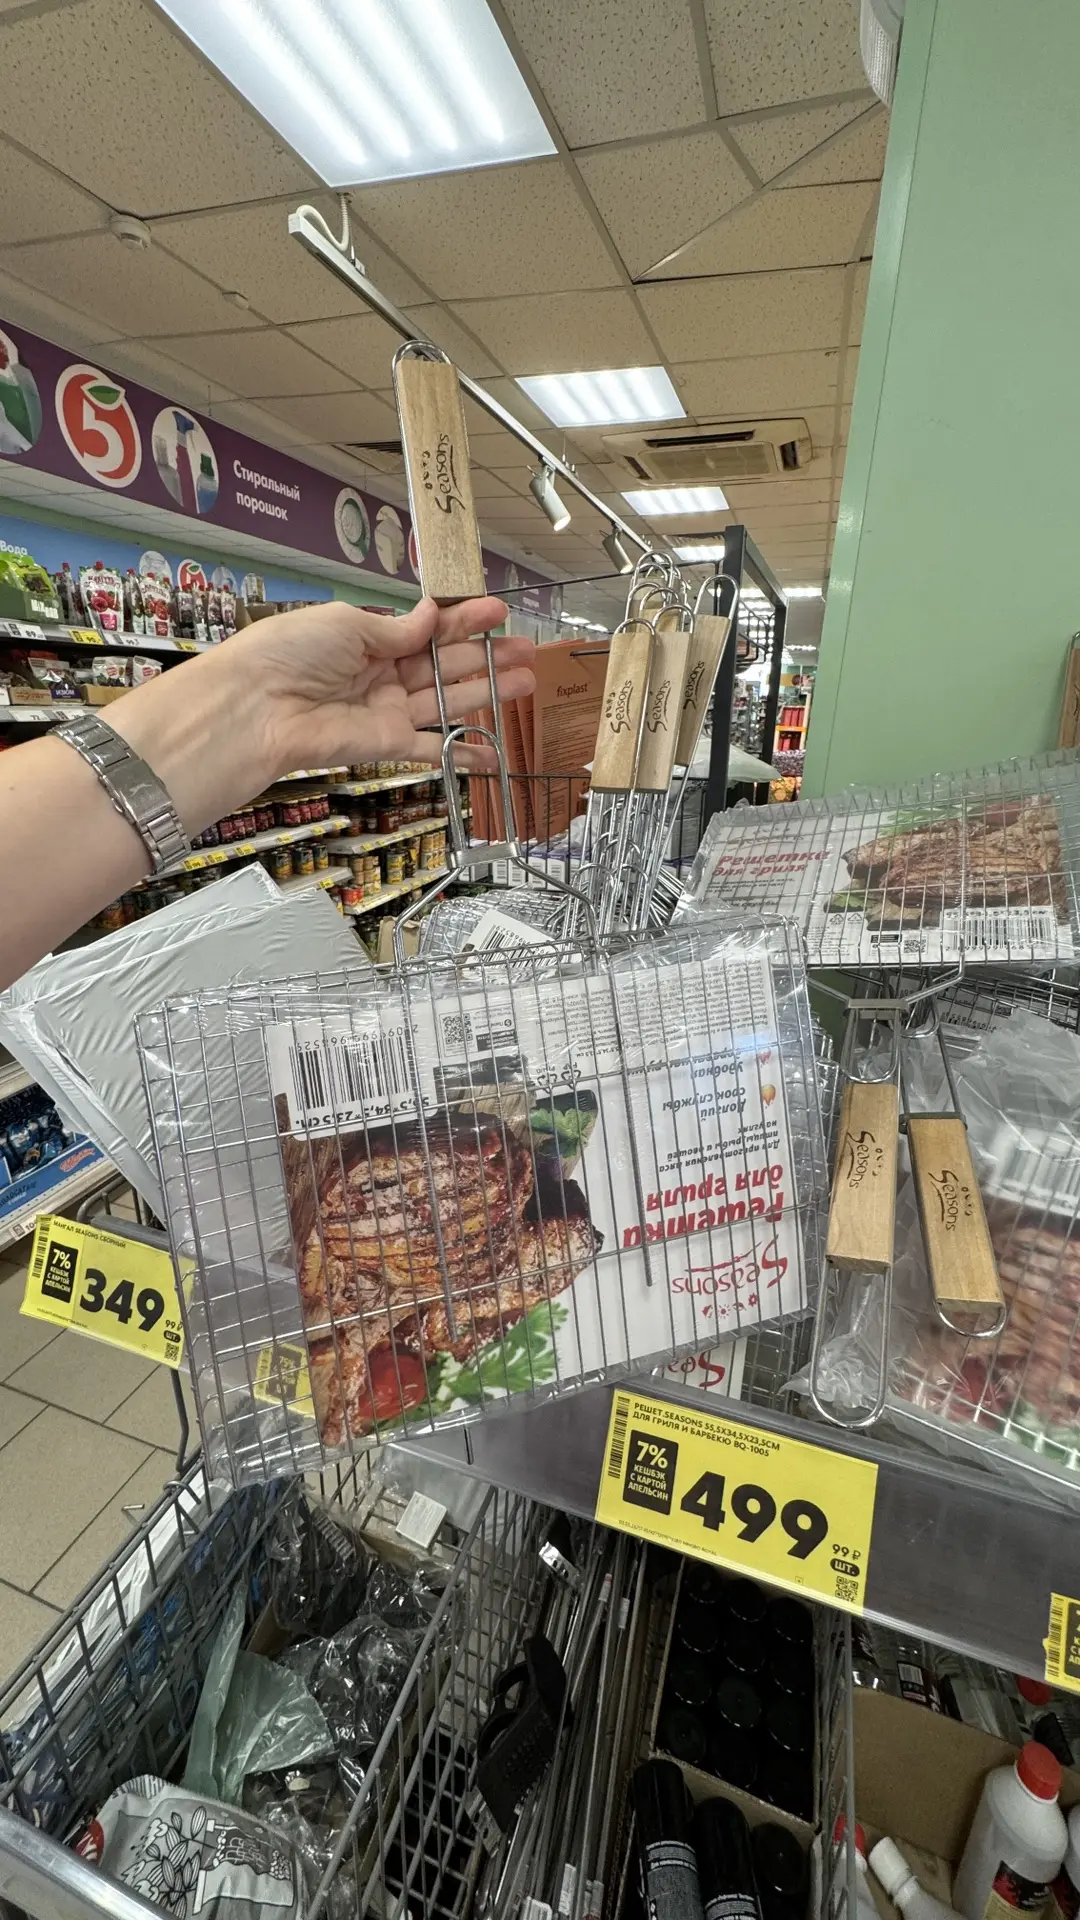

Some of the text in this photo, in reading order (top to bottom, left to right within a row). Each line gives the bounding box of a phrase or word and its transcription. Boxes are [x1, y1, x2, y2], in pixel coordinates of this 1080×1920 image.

[233, 460, 300, 501] Стиральный
[436, 433, 466, 515] Seasons
[236, 491, 288, 521] порошок
[556, 682, 588, 698] fixplast
[683, 660, 706, 712] Seasons
[610, 679, 633, 734] Seasons
[647, 679, 673, 733] Seasons
[691, 1061, 744, 1079] Удобная
[662, 1087, 745, 1112] срок службы
[700, 1099, 746, 1122] Долгий
[766, 1120, 777, 1128] на
[715, 1137, 742, 1151] рыбы
[846, 1130, 877, 1188] Seasons
[646, 1165, 783, 1212] для гриля
[928, 1168, 961, 1232] Seasons
[52, 1248, 72, 1269] 7%
[671, 1233, 788, 1297] Seasons
[50, 1266, 69, 1278] КЕШБЭК
[52, 1273, 70, 1286] КАРТОЙ
[44, 1279, 71, 1293] АПЕЛЬСИН
[79, 1268, 165, 1332] 349
[165, 1319, 176, 1330] 99
[632, 1410, 770, 1457] ДЛЯ ГРИЛЯ И БАРБЕКЮ BQ-1005
[635, 1440, 669, 1469] 7%
[630, 1473, 667, 1491] С КАРТОЙ
[633, 1464, 666, 1481] КЕШБЭК
[627, 1481, 669, 1501] АПЕЛЬСИН
[680, 1470, 829, 1560] 499
[832, 1543, 850, 1558] 99
[832, 1560, 858, 1576] ШТ.
